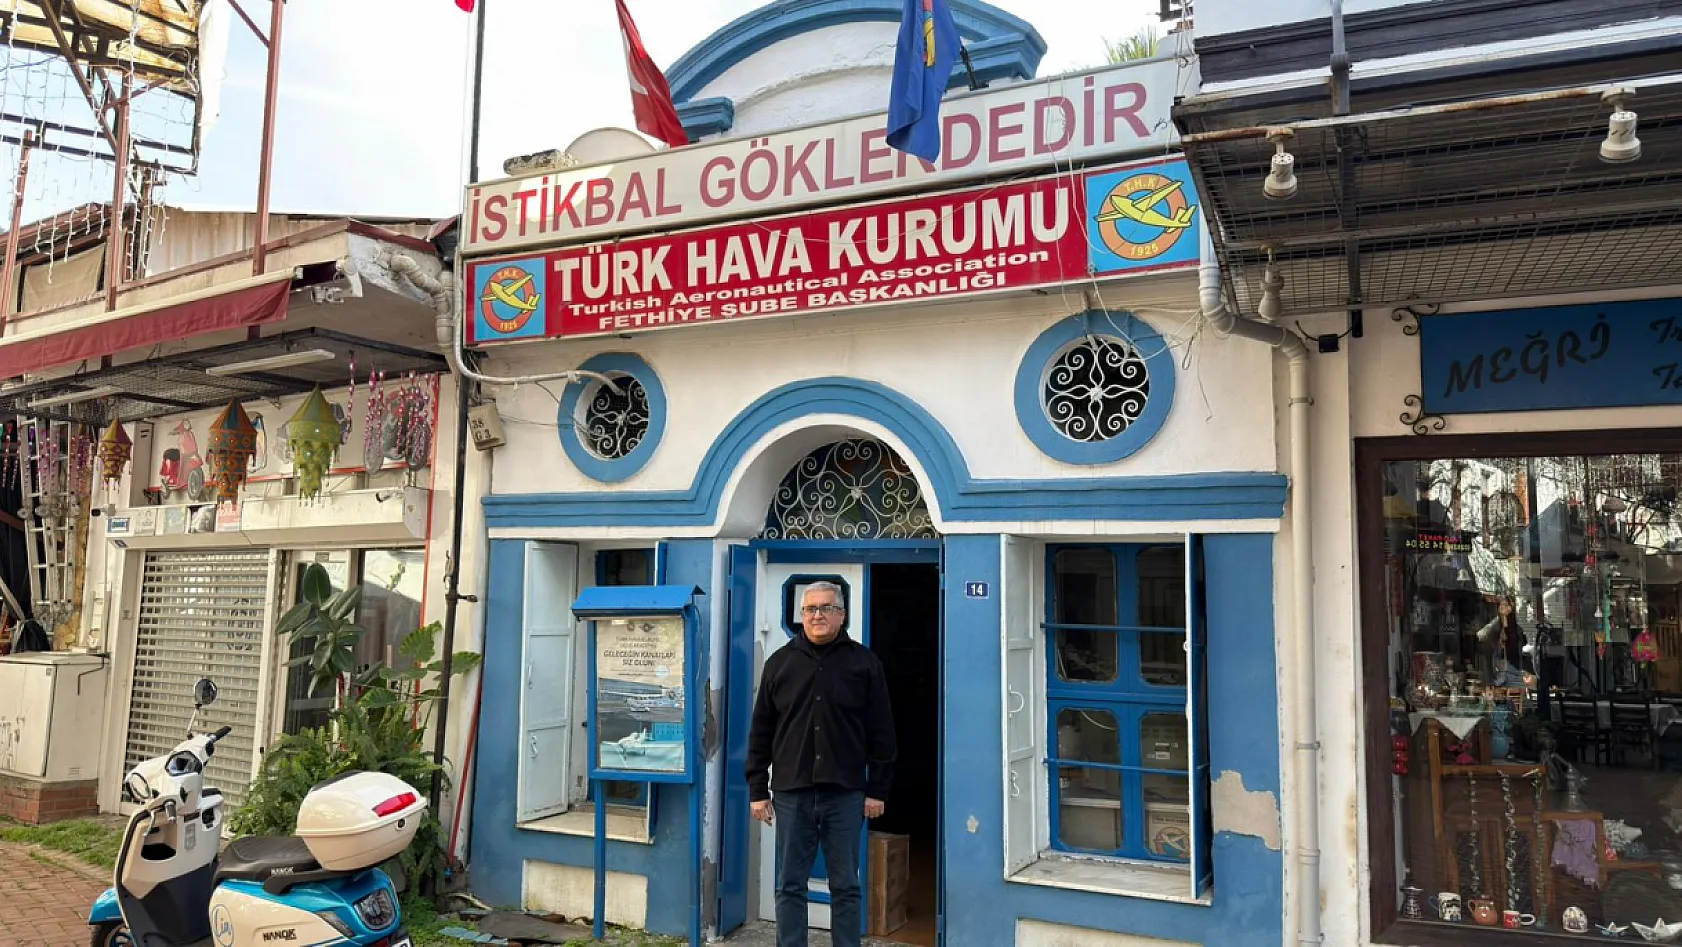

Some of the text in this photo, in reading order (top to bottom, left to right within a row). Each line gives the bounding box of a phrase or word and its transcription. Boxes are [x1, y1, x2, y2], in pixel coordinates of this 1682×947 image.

[470, 167, 682, 244] İSTİKBAL
[554, 187, 1069, 302] TÜRK HAVA KURUMU
[568, 250, 1049, 317] Turkish Aeronautical Association
[599, 271, 1006, 330] FETHİYE ŞUBE BAŞKANLIĞI
[970, 583, 983, 596] 14
